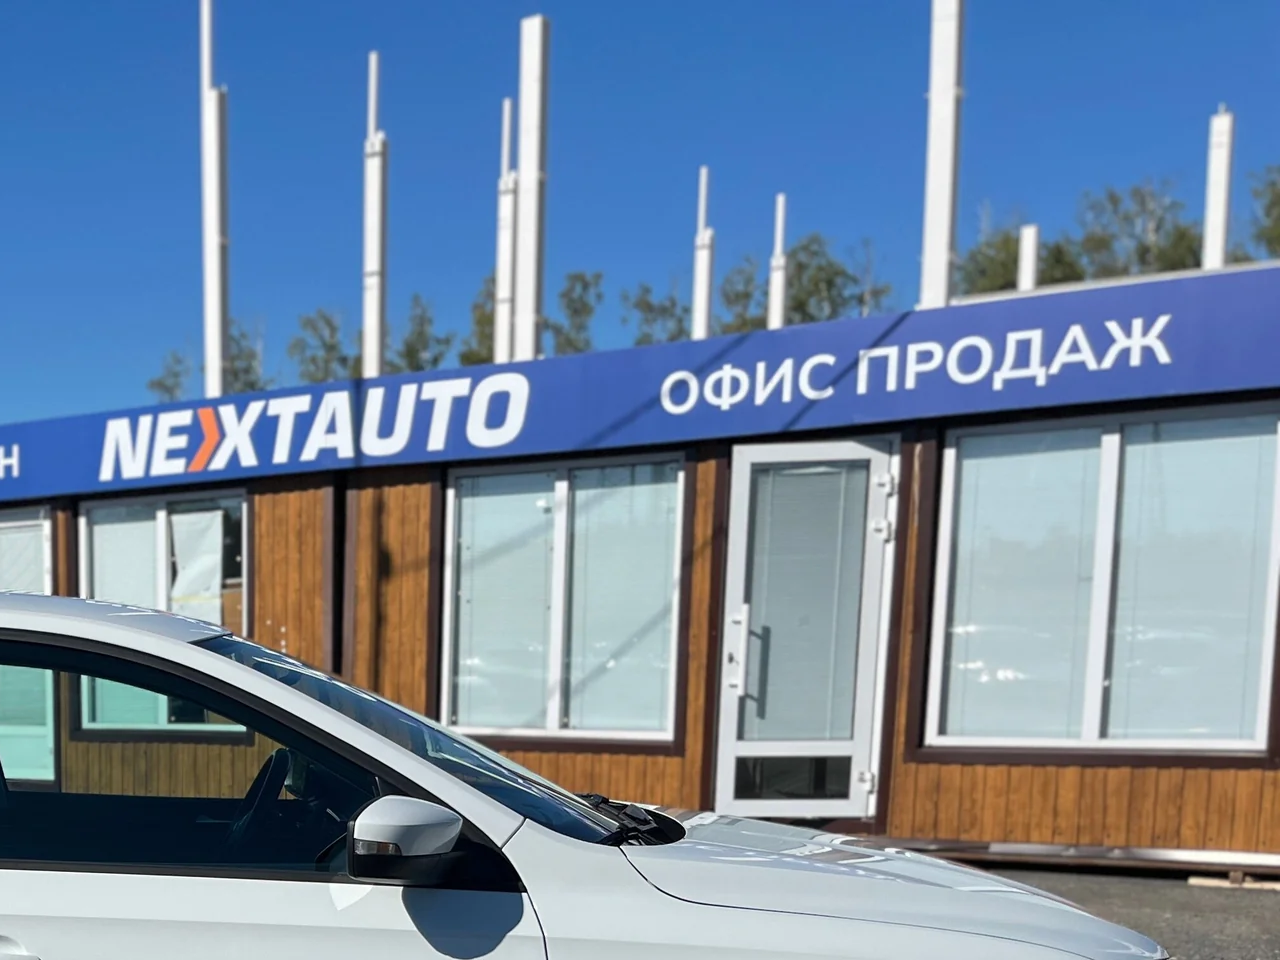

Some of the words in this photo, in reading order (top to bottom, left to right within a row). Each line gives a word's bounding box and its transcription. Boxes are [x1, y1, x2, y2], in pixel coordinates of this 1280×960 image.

[659, 352, 837, 416] ОФИС
[855, 313, 1173, 396] ПРОДАЖ
[98, 371, 531, 483] NEXTAUTO
